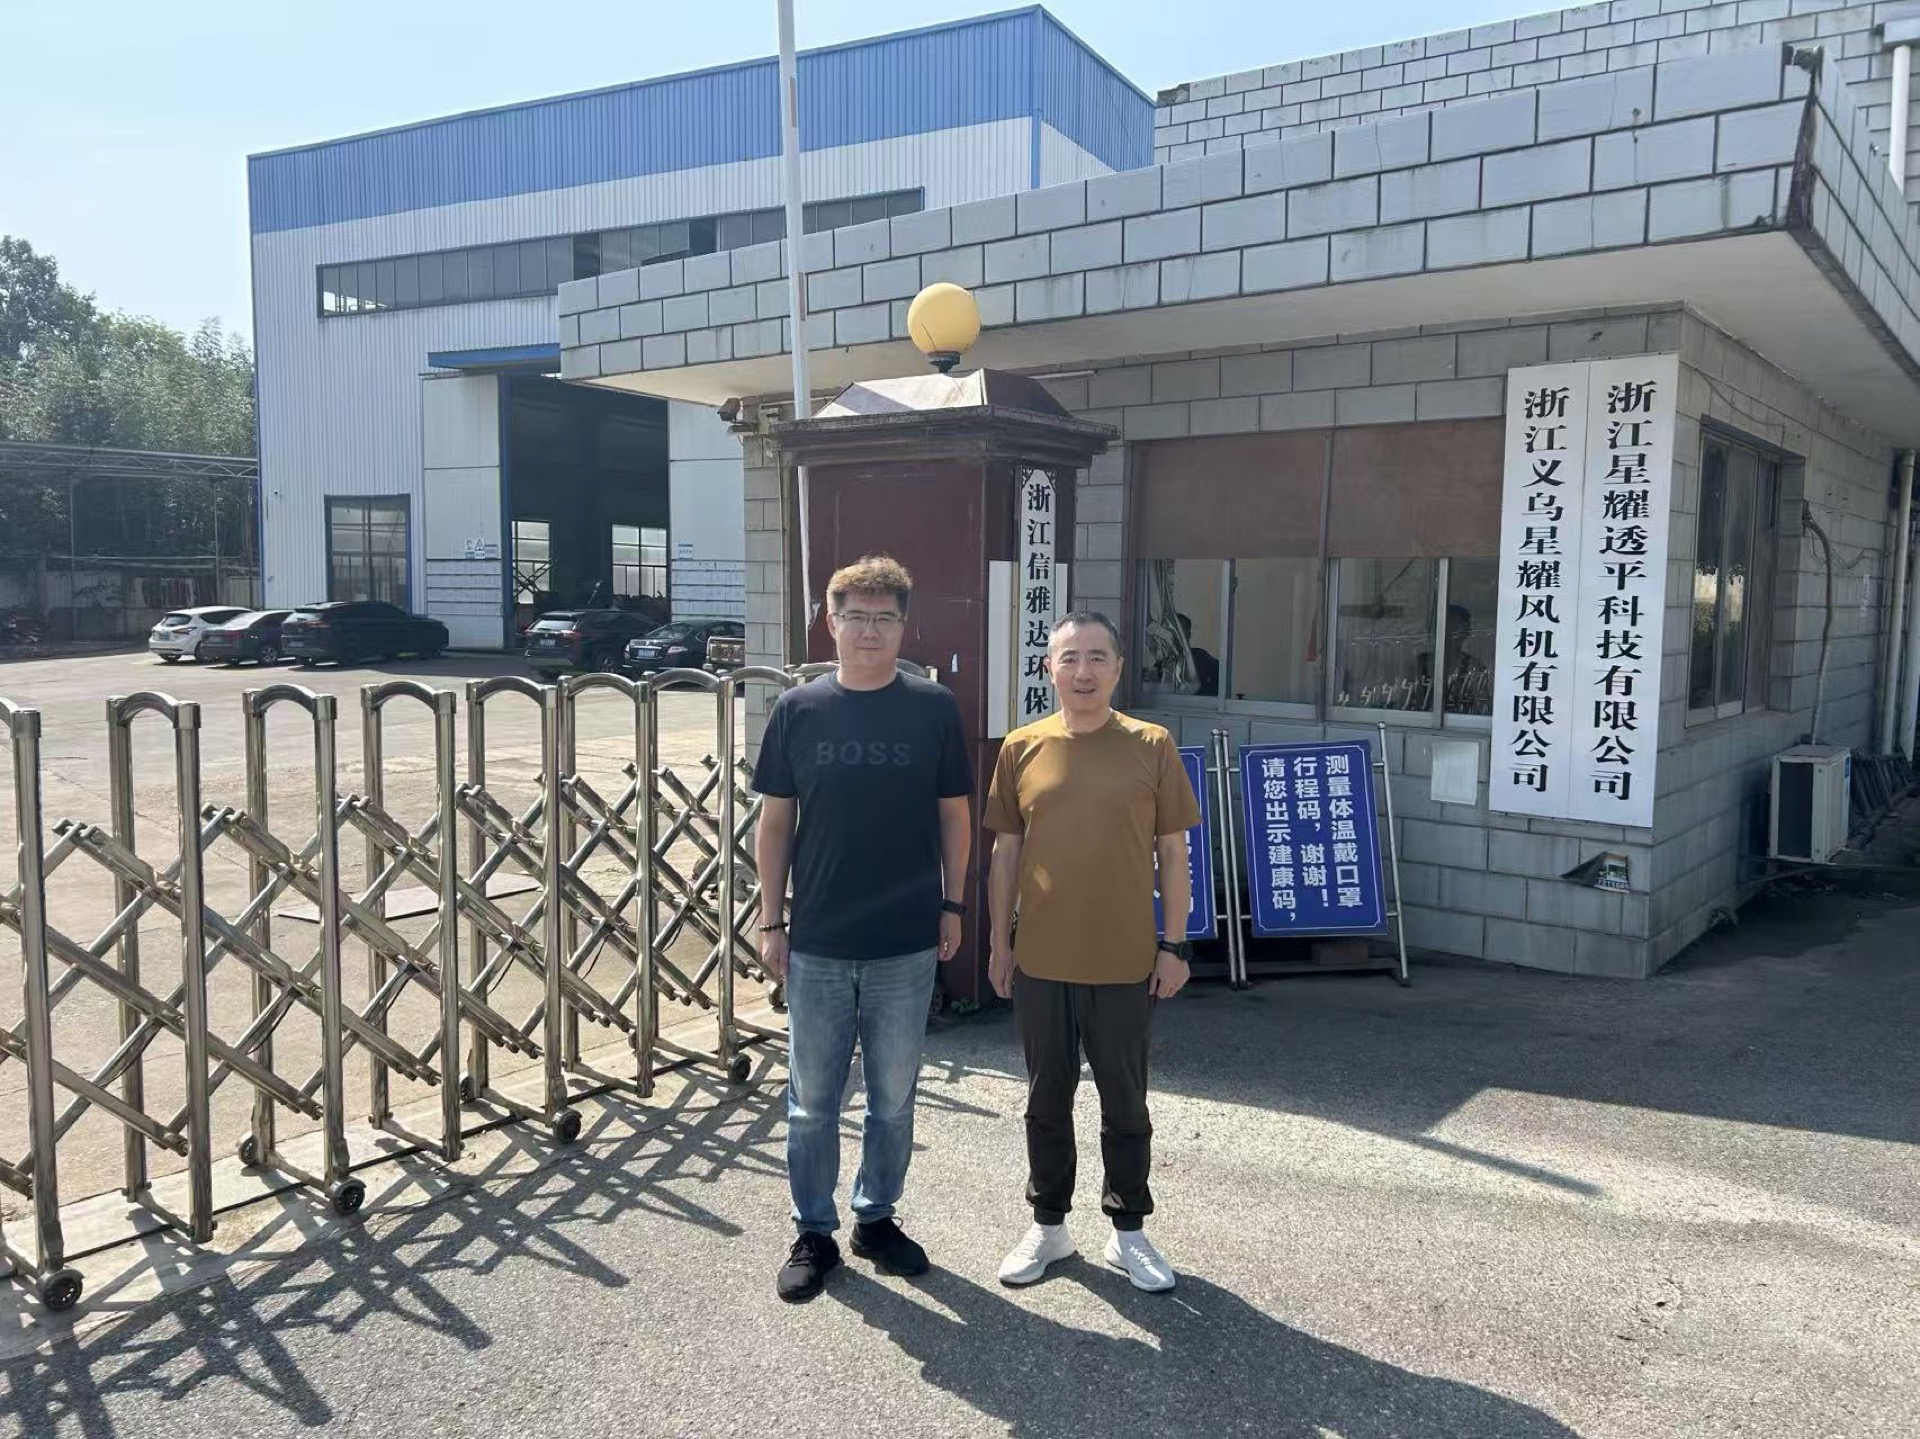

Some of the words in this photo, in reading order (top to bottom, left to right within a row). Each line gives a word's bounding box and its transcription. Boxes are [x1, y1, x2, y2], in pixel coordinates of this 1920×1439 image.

[1023, 483, 1050, 715] 浙江信雅达环保
[1512, 386, 1571, 793] 浙江义乌星耀风机有限公司
[1589, 380, 1656, 801] 浙江星耀透平科技有限公司
[815, 741, 911, 766] BOSS
[1325, 754, 1363, 908] 测量体温戴口罩
